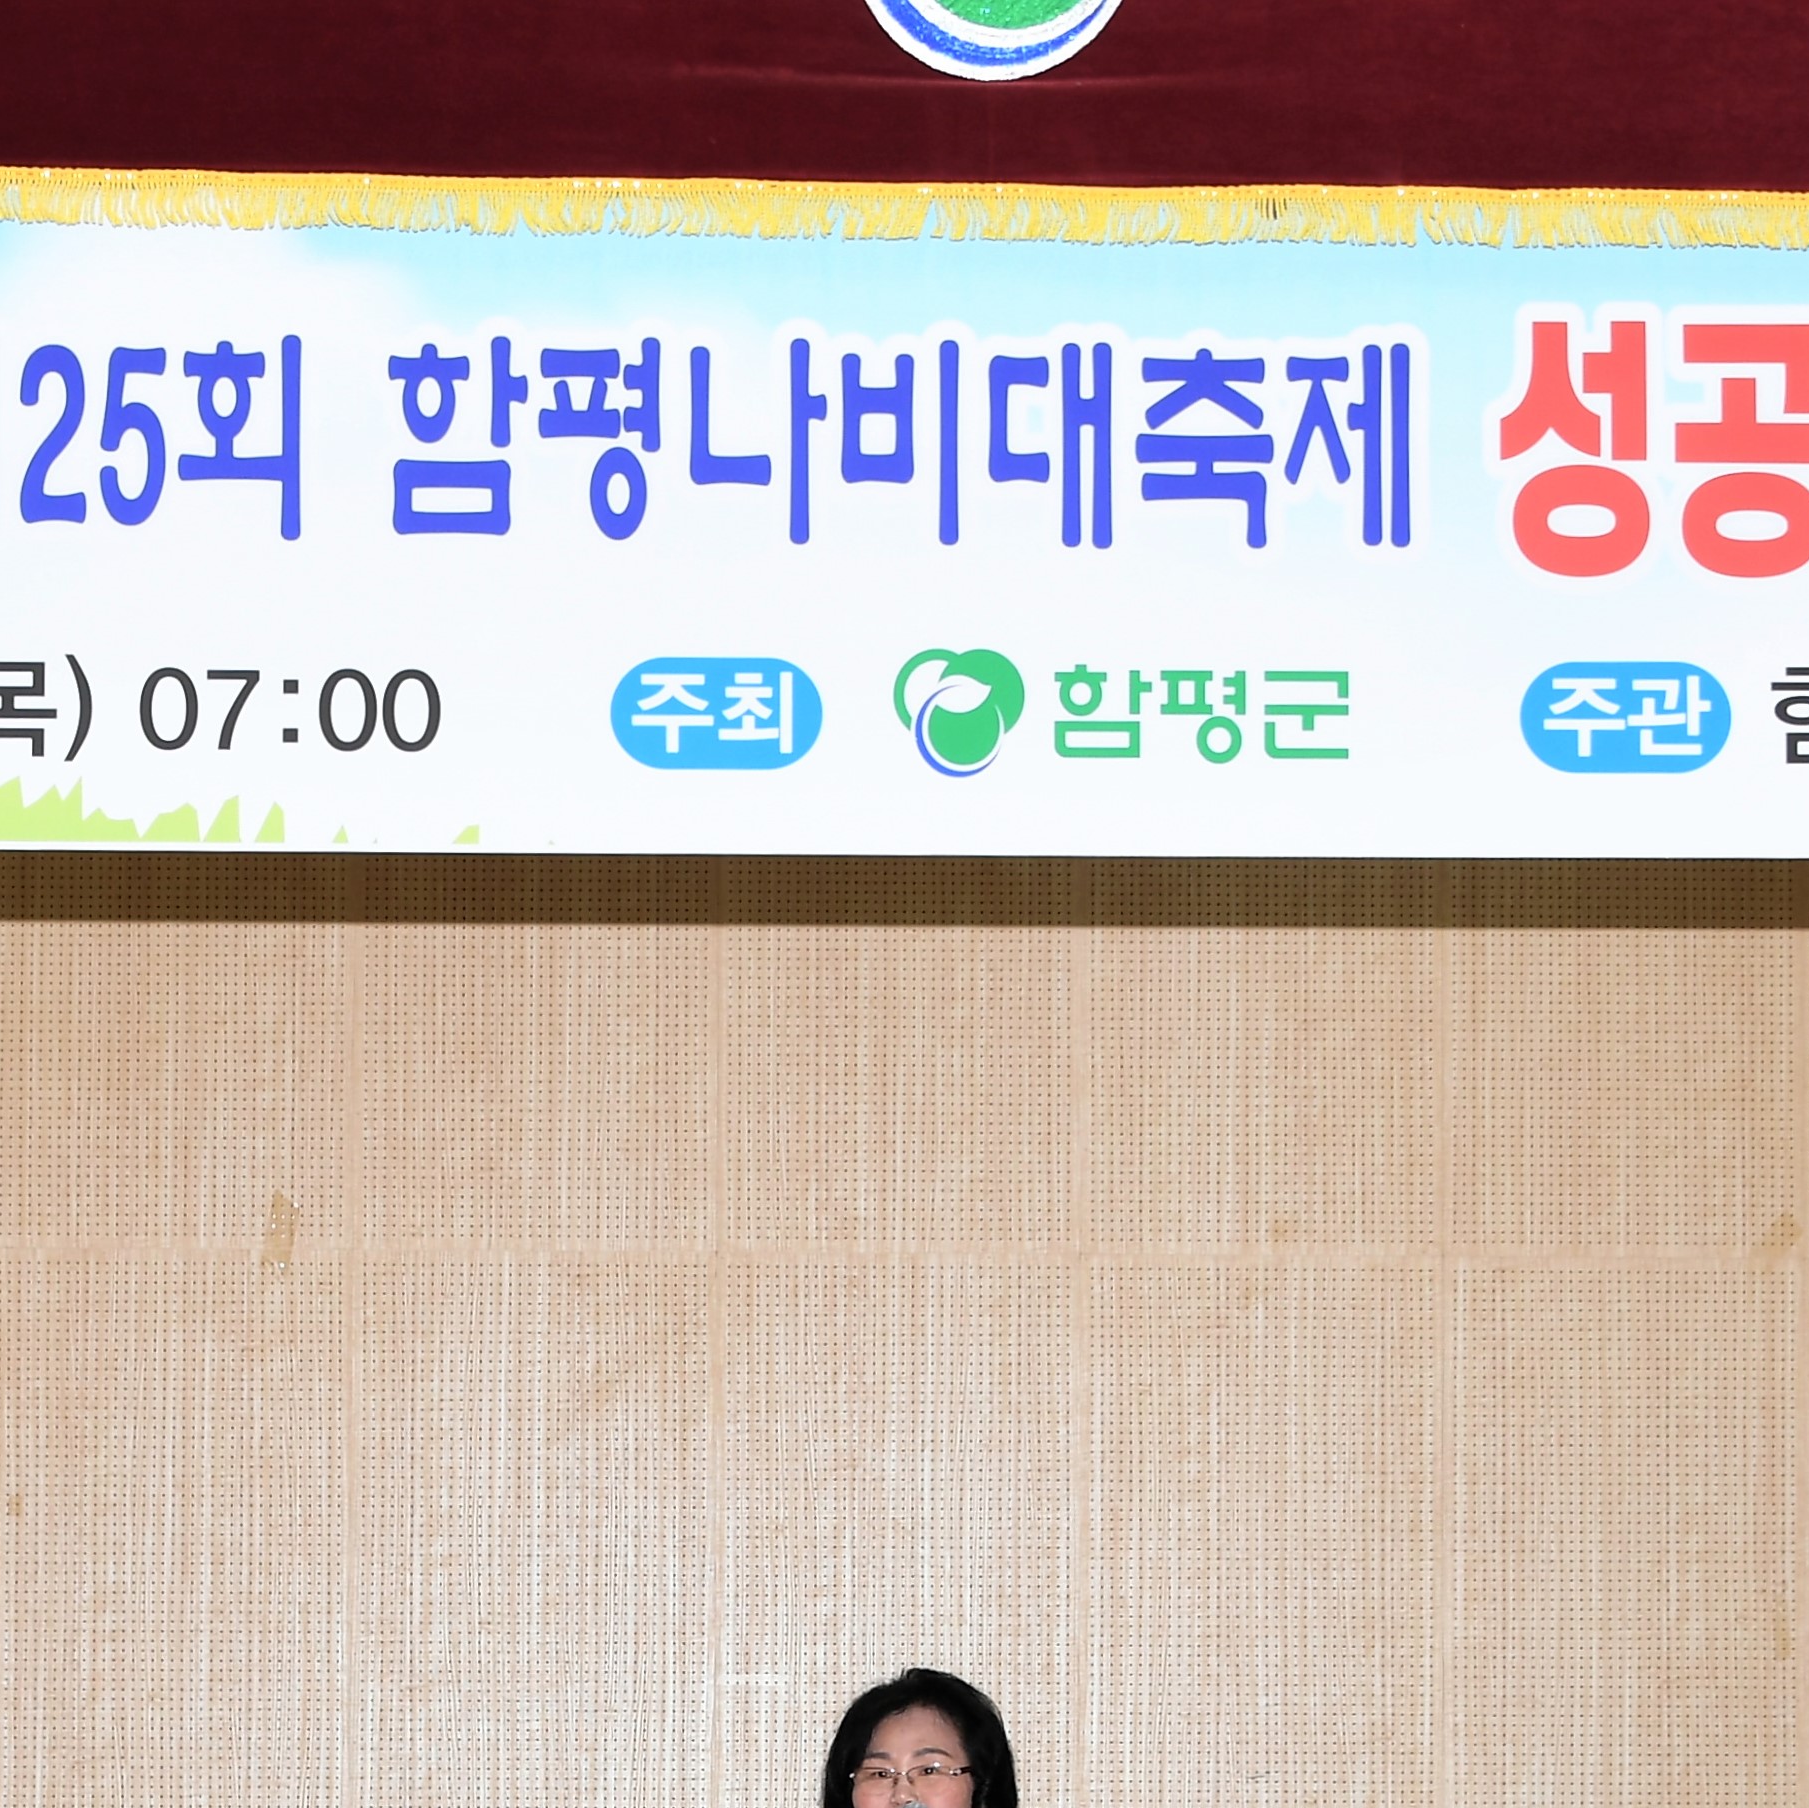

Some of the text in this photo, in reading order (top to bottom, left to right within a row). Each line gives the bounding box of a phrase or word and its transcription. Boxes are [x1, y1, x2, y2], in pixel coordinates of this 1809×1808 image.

[388, 335, 1412, 549] 함평나비대축제
[138, 666, 442, 753] 07:00
[630, 661, 1352, 765] 주최 함평군
[1542, 674, 1713, 759] 주관
